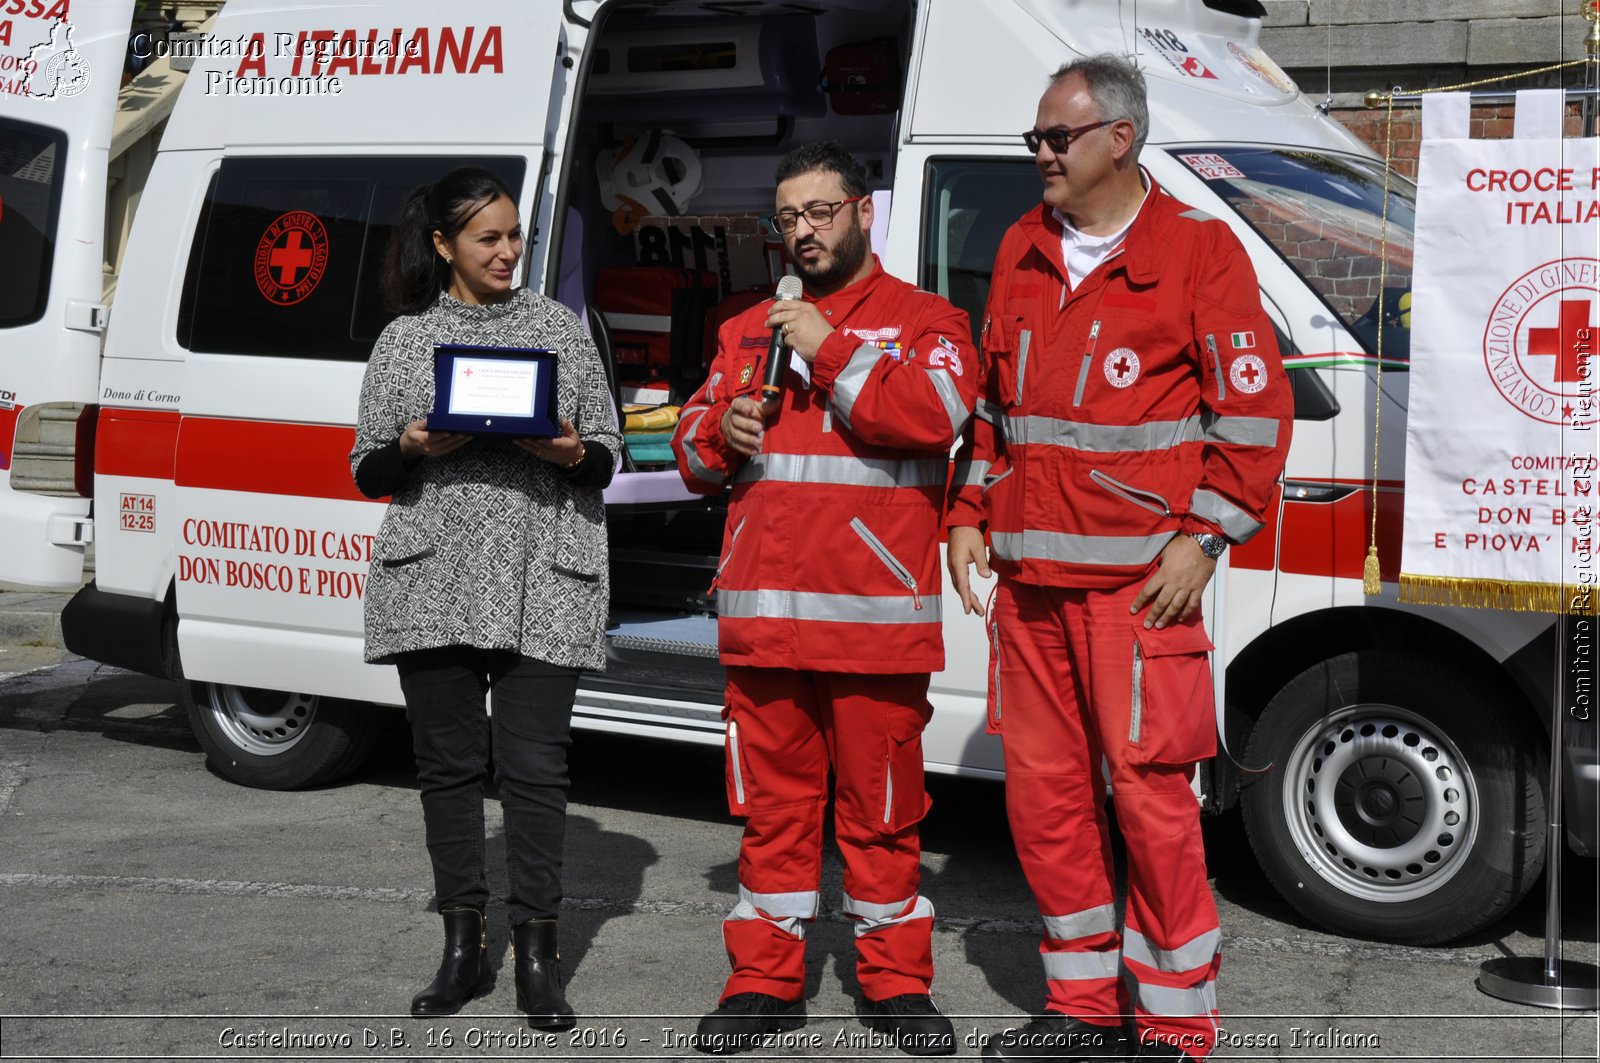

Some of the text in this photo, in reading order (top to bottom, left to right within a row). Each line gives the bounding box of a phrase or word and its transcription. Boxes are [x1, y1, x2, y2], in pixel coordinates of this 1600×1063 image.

[1143, 27, 1189, 53] 118
[291, 26, 504, 77] ITALIANA
[1185, 155, 1225, 166] AT 14
[1199, 166, 1241, 178] 12-25
[1466, 167, 1574, 193] CROCE
[256, 236, 277, 298] CONVENZIONE
[271, 223, 281, 237] DI
[282, 213, 316, 232] GINEVRA
[310, 243, 326, 281] AGOSTO
[1513, 278, 1540, 303] DI
[1489, 299, 1556, 417] CONVENZIONE
[103, 387, 181, 403] Dono di Corno
[1511, 456, 1599, 471] COMITATO
[1462, 478, 1600, 497] CASTELN
[121, 496, 154, 512] AT 14
[121, 513, 154, 531] 12-25
[1478, 507, 1531, 525] DON
[183, 518, 376, 562] COMITATO DI CAST
[1434, 532, 1447, 549] E
[178, 555, 367, 601] DON BOSCO E PIOV
